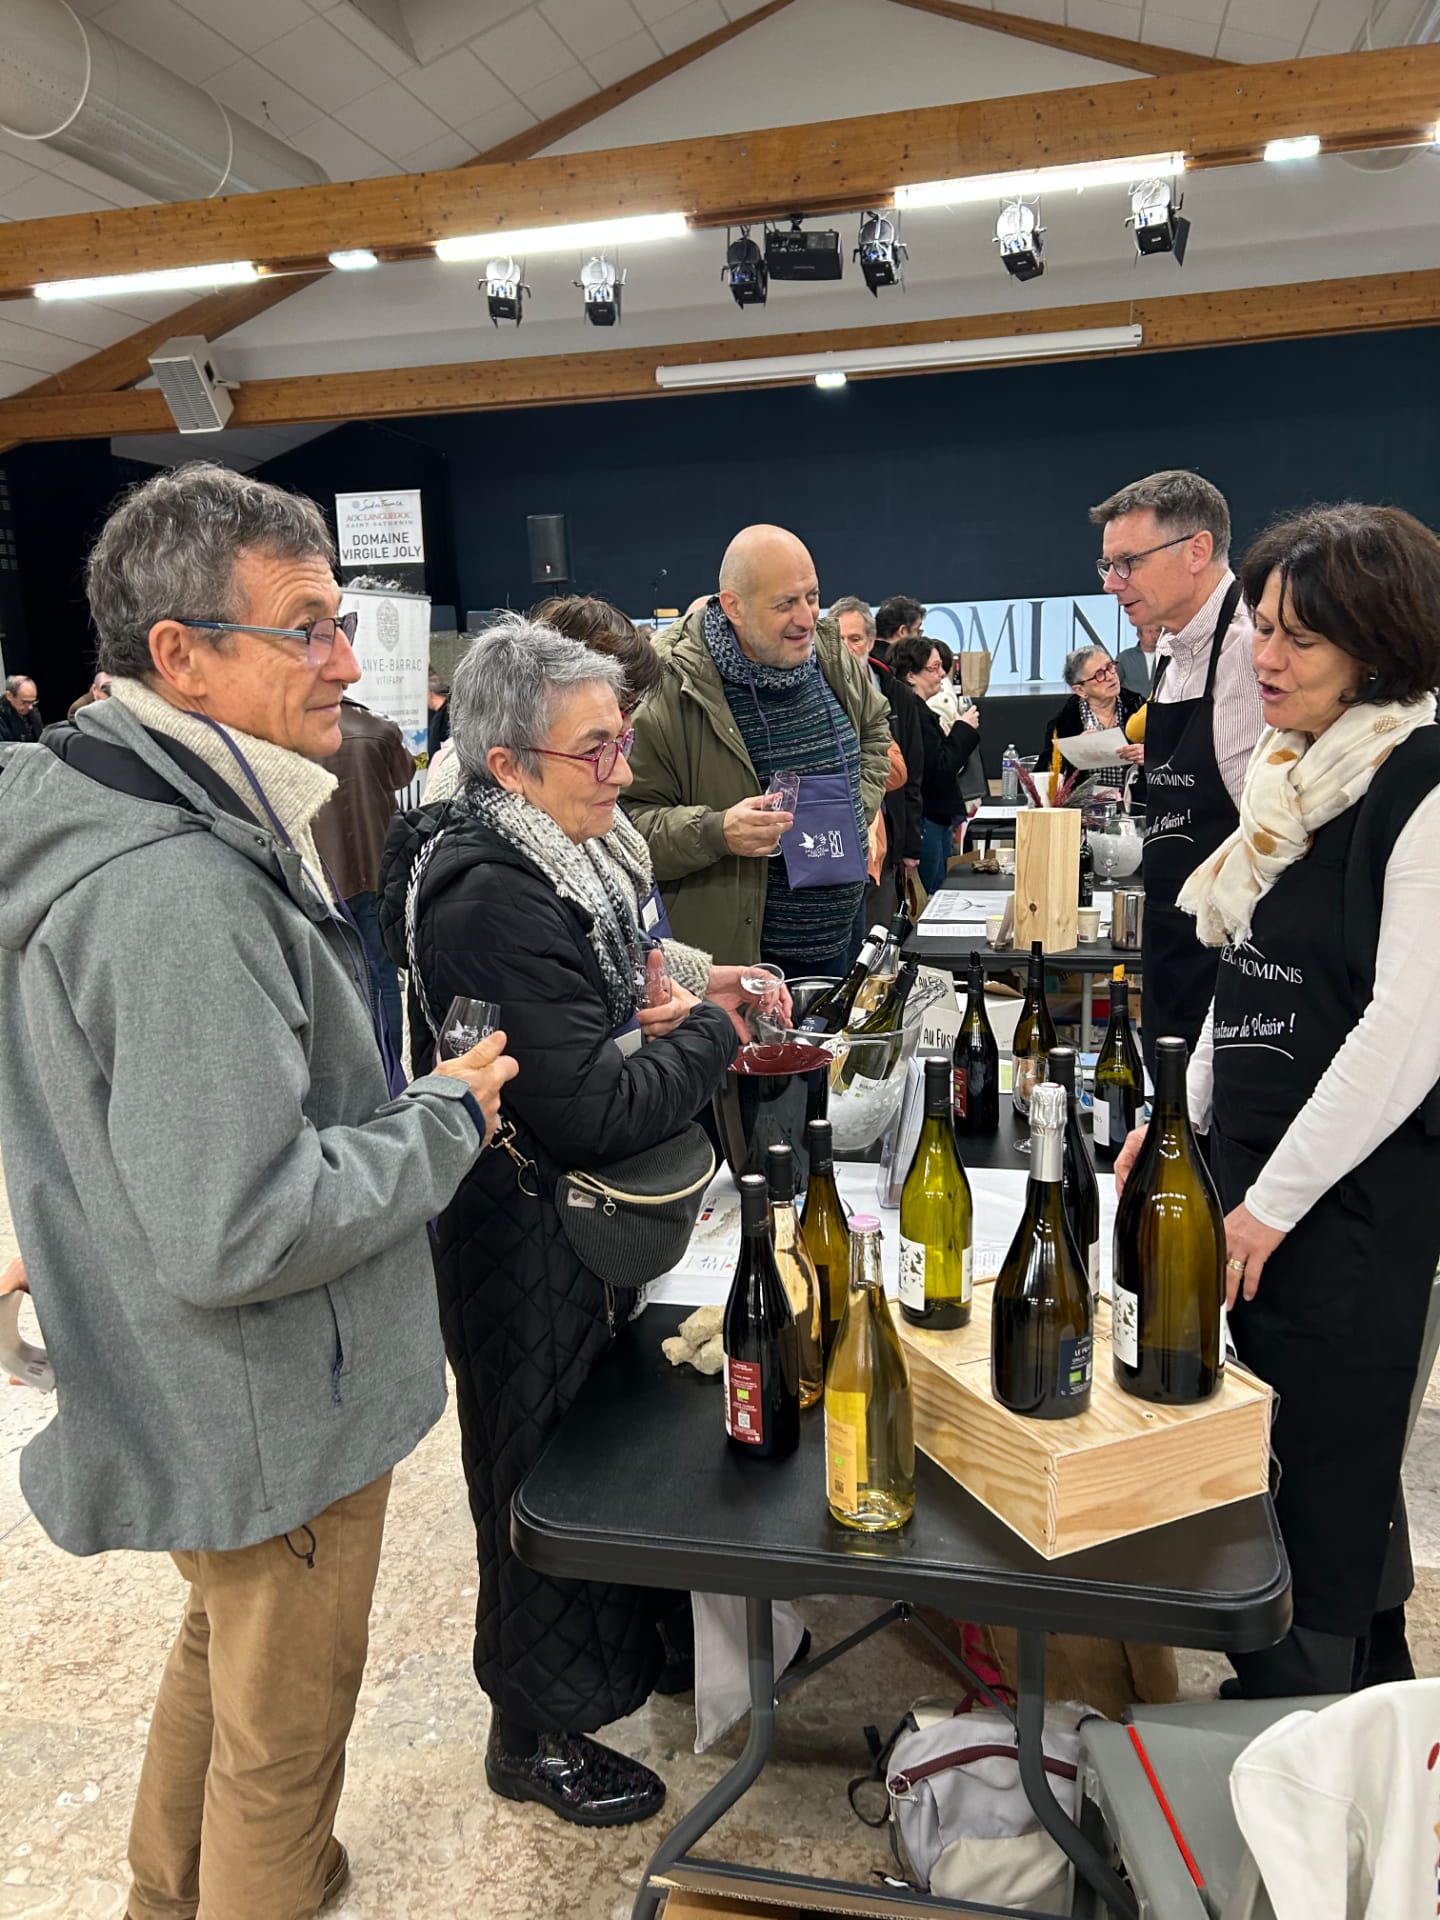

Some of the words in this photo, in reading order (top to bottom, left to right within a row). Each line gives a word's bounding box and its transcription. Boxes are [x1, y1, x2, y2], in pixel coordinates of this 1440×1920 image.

[352, 531, 410, 546] DOMAINE
[342, 547, 390, 560] VIRGILE
[392, 545, 422, 558] JOLY
[362, 658, 423, 672] ANYE-BARRAC
[1240, 1014, 1251, 1038] de
[1251, 1012, 1285, 1037] Plaisir
[1288, 1012, 1296, 1033] !
